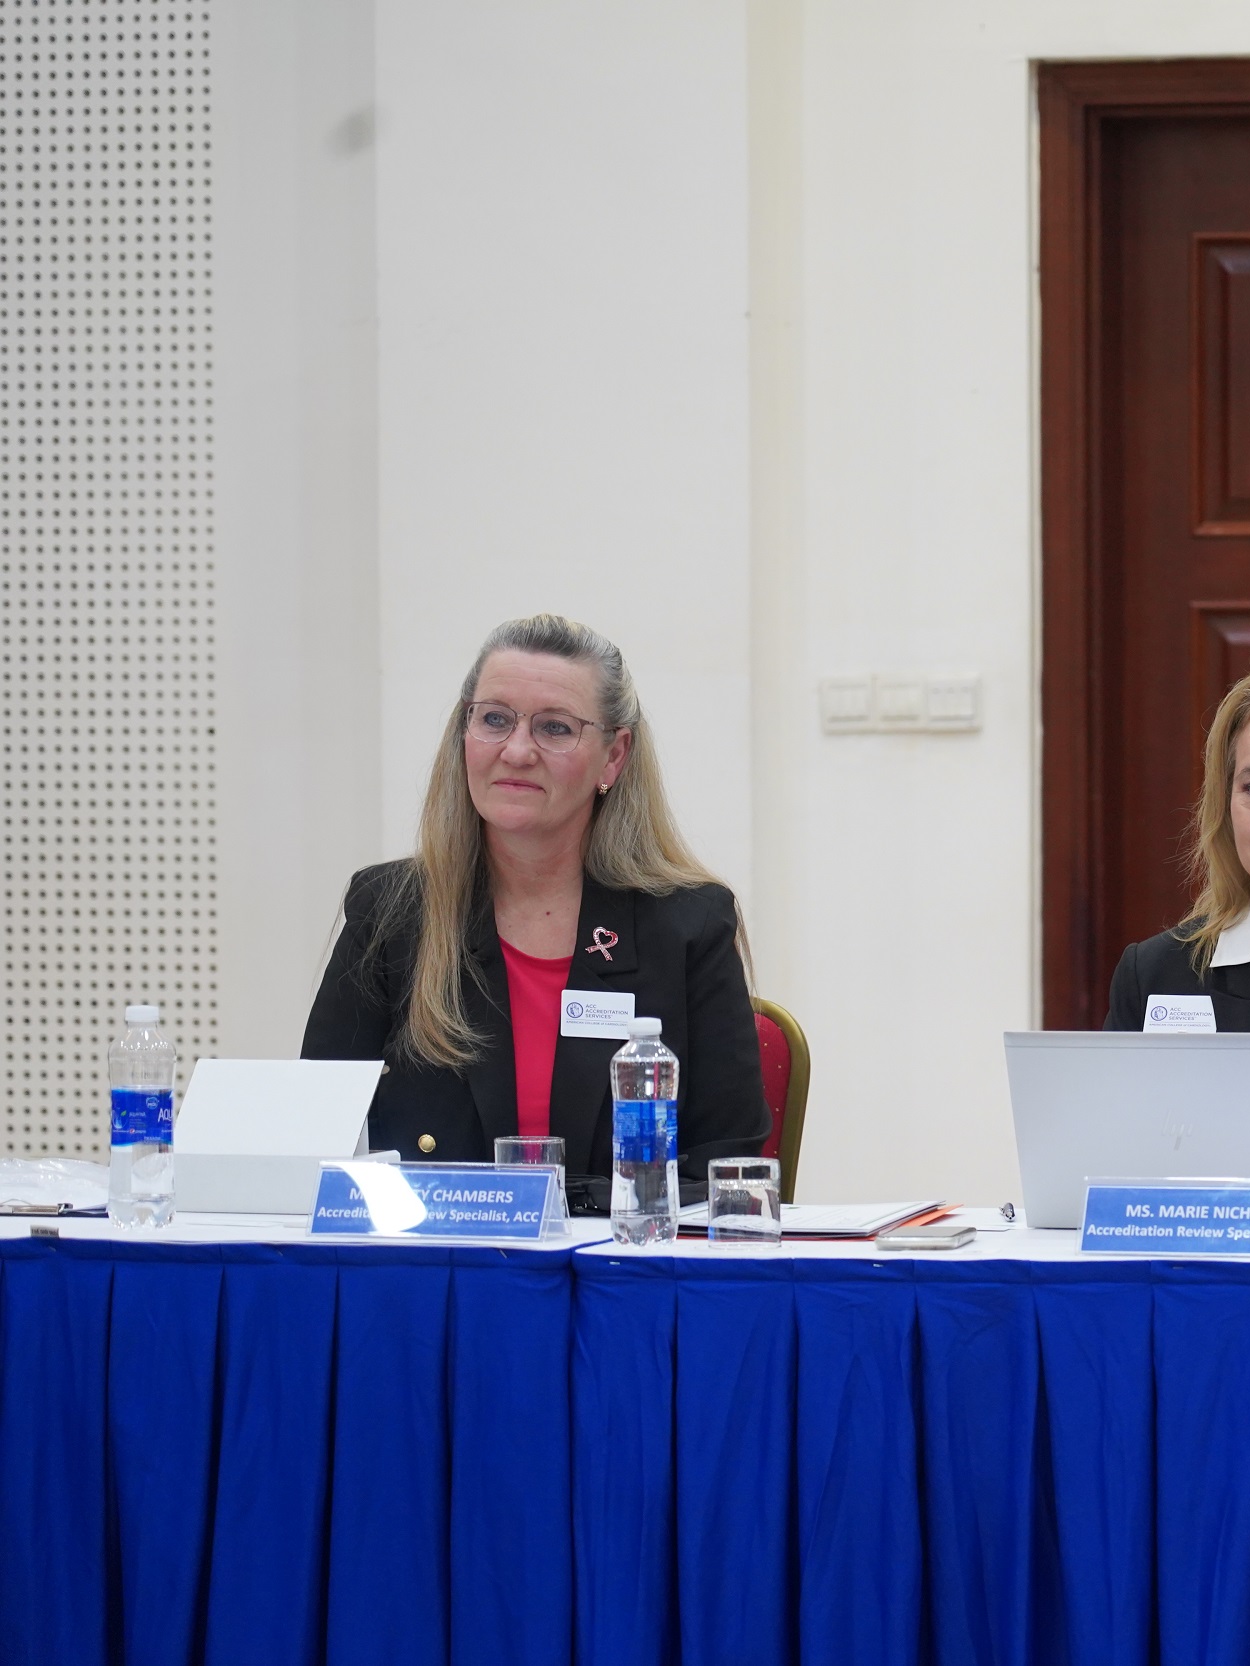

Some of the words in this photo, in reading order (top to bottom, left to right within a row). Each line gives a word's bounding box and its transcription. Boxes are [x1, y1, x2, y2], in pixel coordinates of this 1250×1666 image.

[432, 1189, 513, 1204] CHAMBERS
[449, 1210, 510, 1223] Specialist,
[513, 1211, 539, 1223] ACC
[1125, 1204, 1154, 1218] MS.
[1159, 1205, 1209, 1219] MARIE
[1087, 1224, 1173, 1237] Accreditation
[1176, 1226, 1223, 1238] Review
